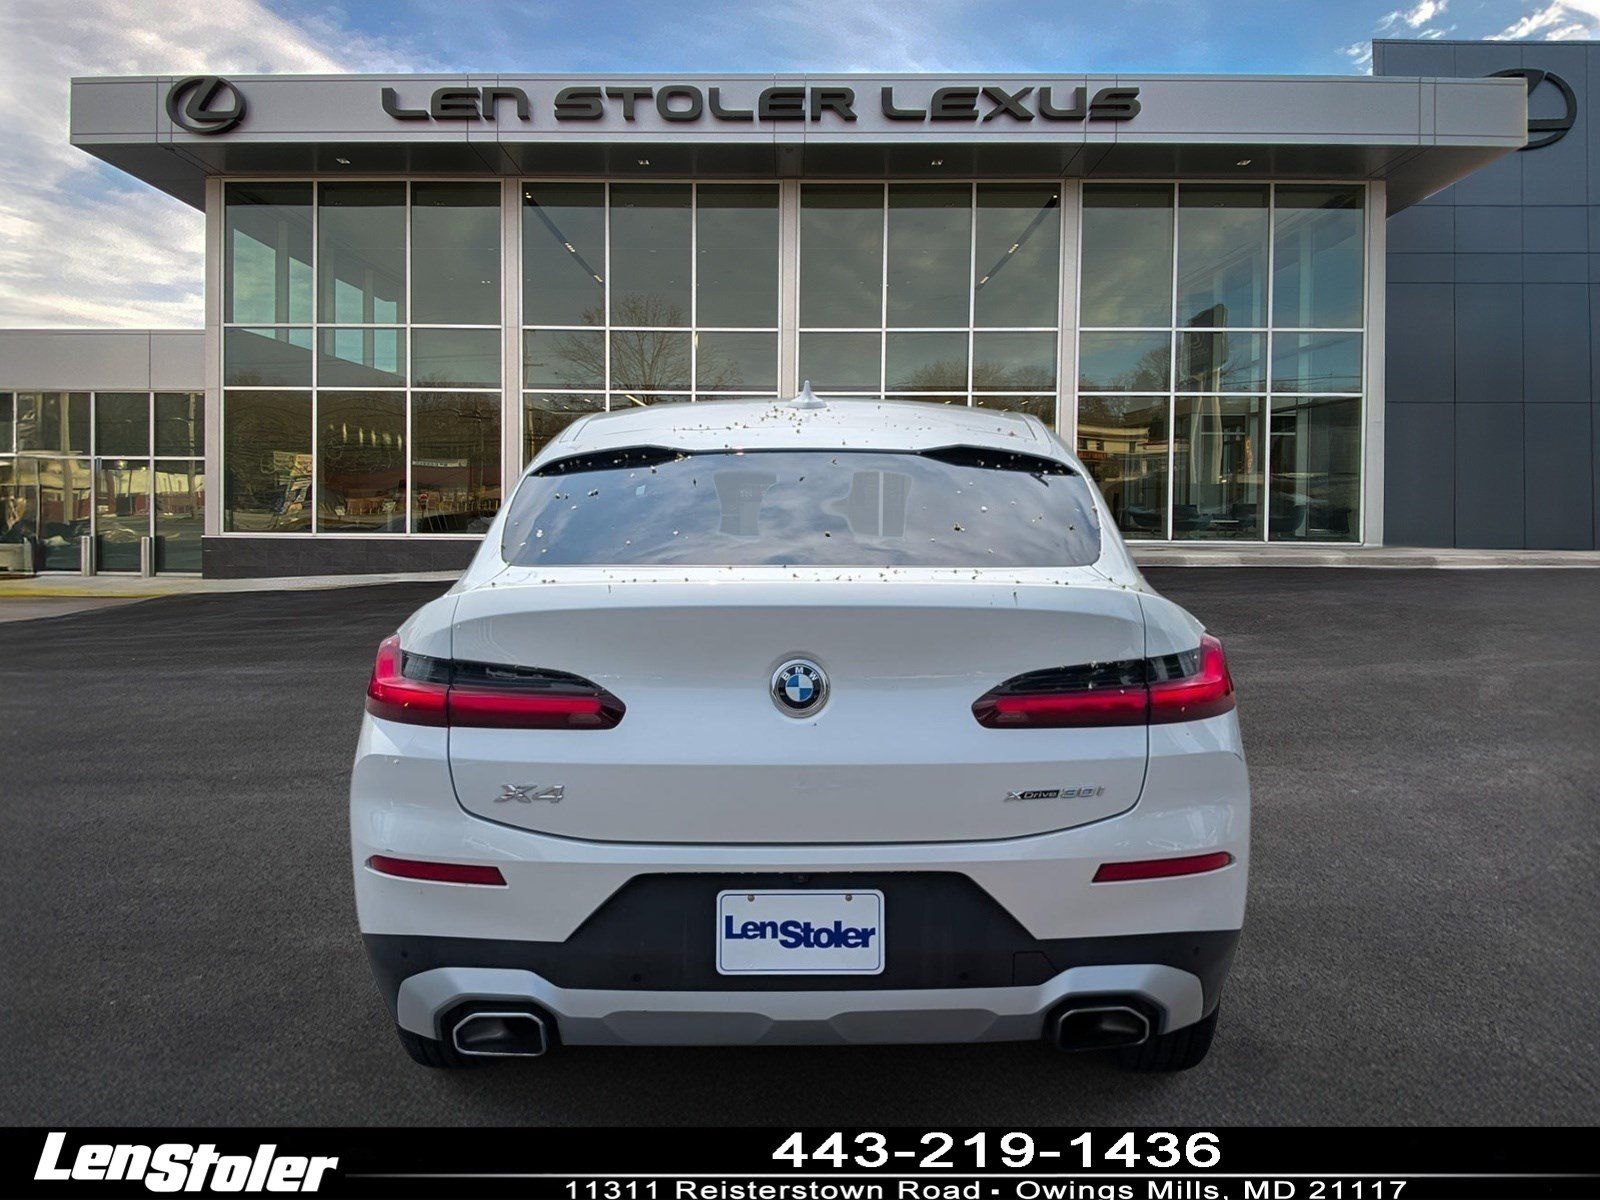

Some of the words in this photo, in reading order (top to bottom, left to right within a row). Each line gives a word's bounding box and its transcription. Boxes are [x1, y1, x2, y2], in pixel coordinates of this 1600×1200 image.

[381, 86, 531, 121] LEN
[554, 85, 858, 122] STOLER
[881, 86, 1142, 121] LEXUS
[781, 666, 818, 681] BMW
[494, 784, 565, 804] X4
